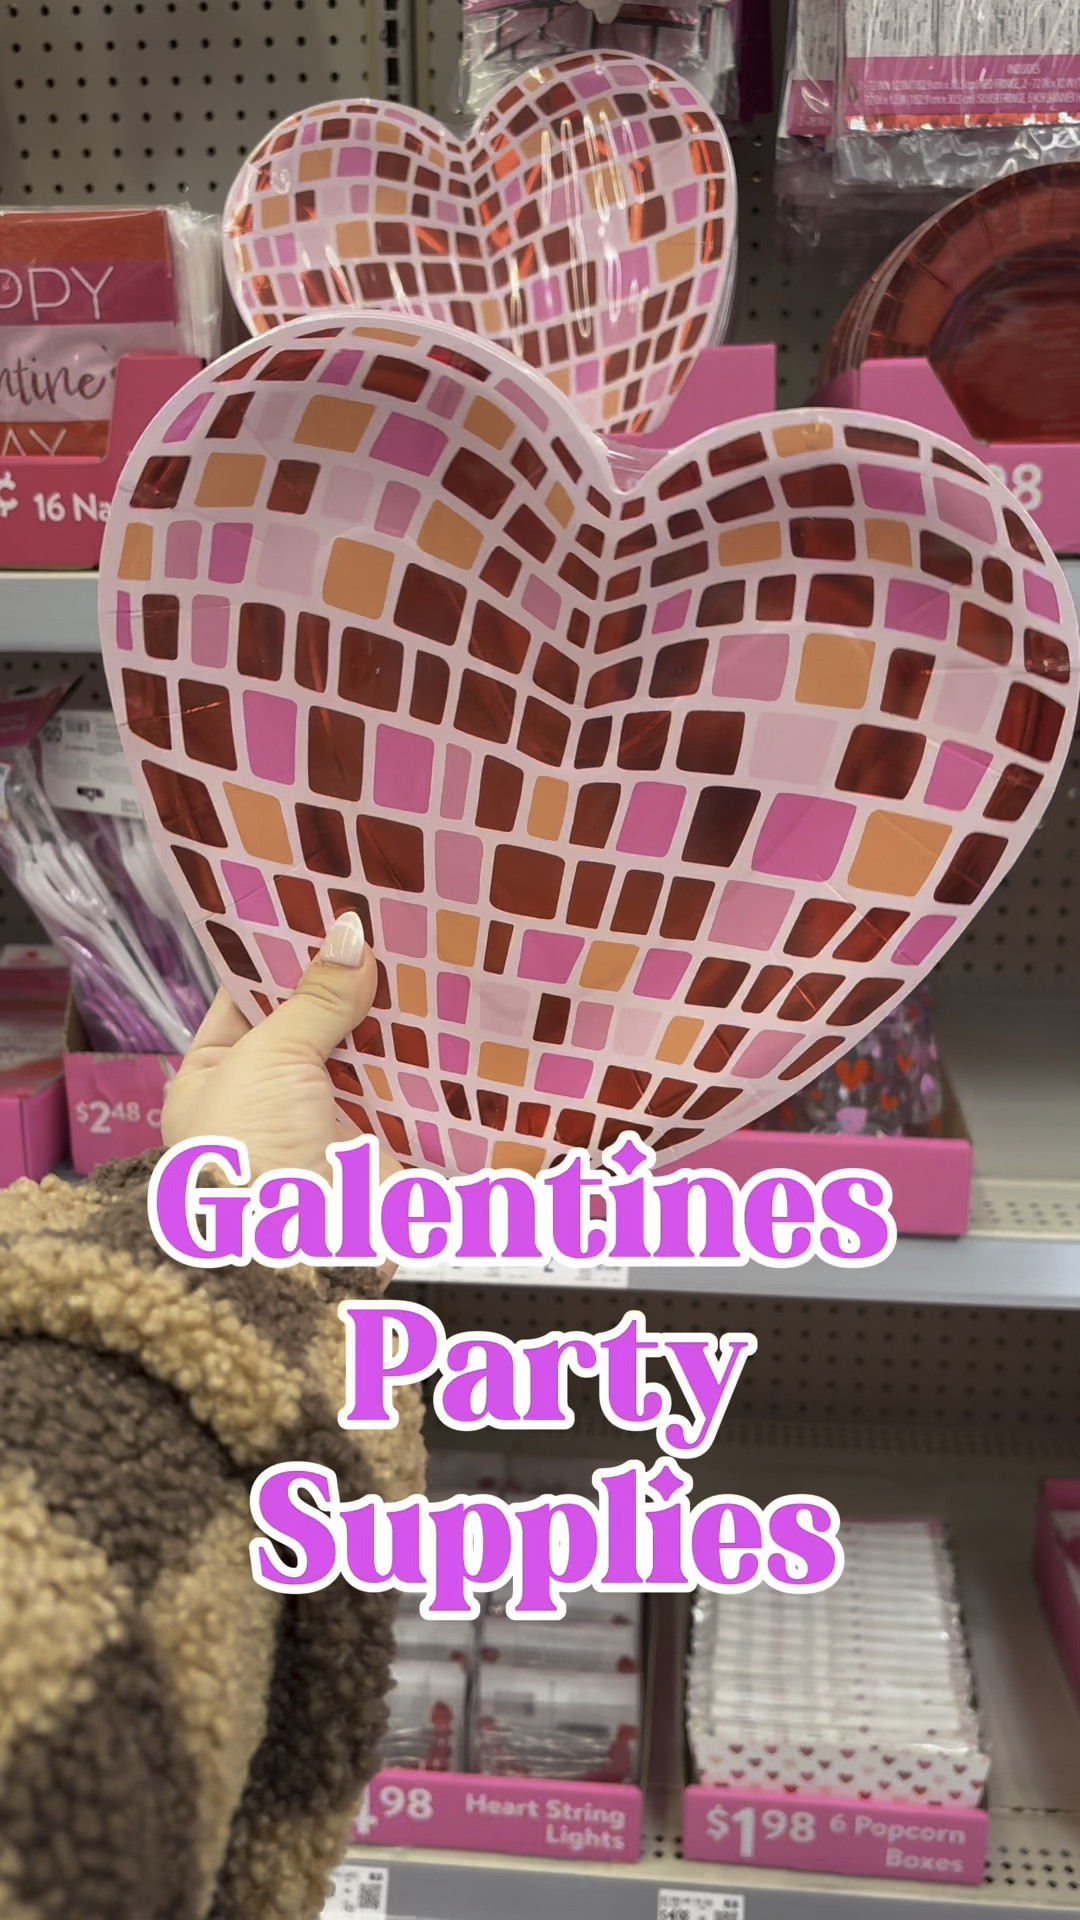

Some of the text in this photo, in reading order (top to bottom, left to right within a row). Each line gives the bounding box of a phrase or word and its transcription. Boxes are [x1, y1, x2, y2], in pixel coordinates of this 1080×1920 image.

[33, 492, 66, 522] 16
[465, 1793, 540, 1818] Heart
[546, 1799, 626, 1829] String
[546, 1824, 626, 1851] Lights
[829, 1813, 847, 1834] 6
[854, 1814, 967, 1844] Popcorn
[885, 1847, 965, 1873] Boxes
